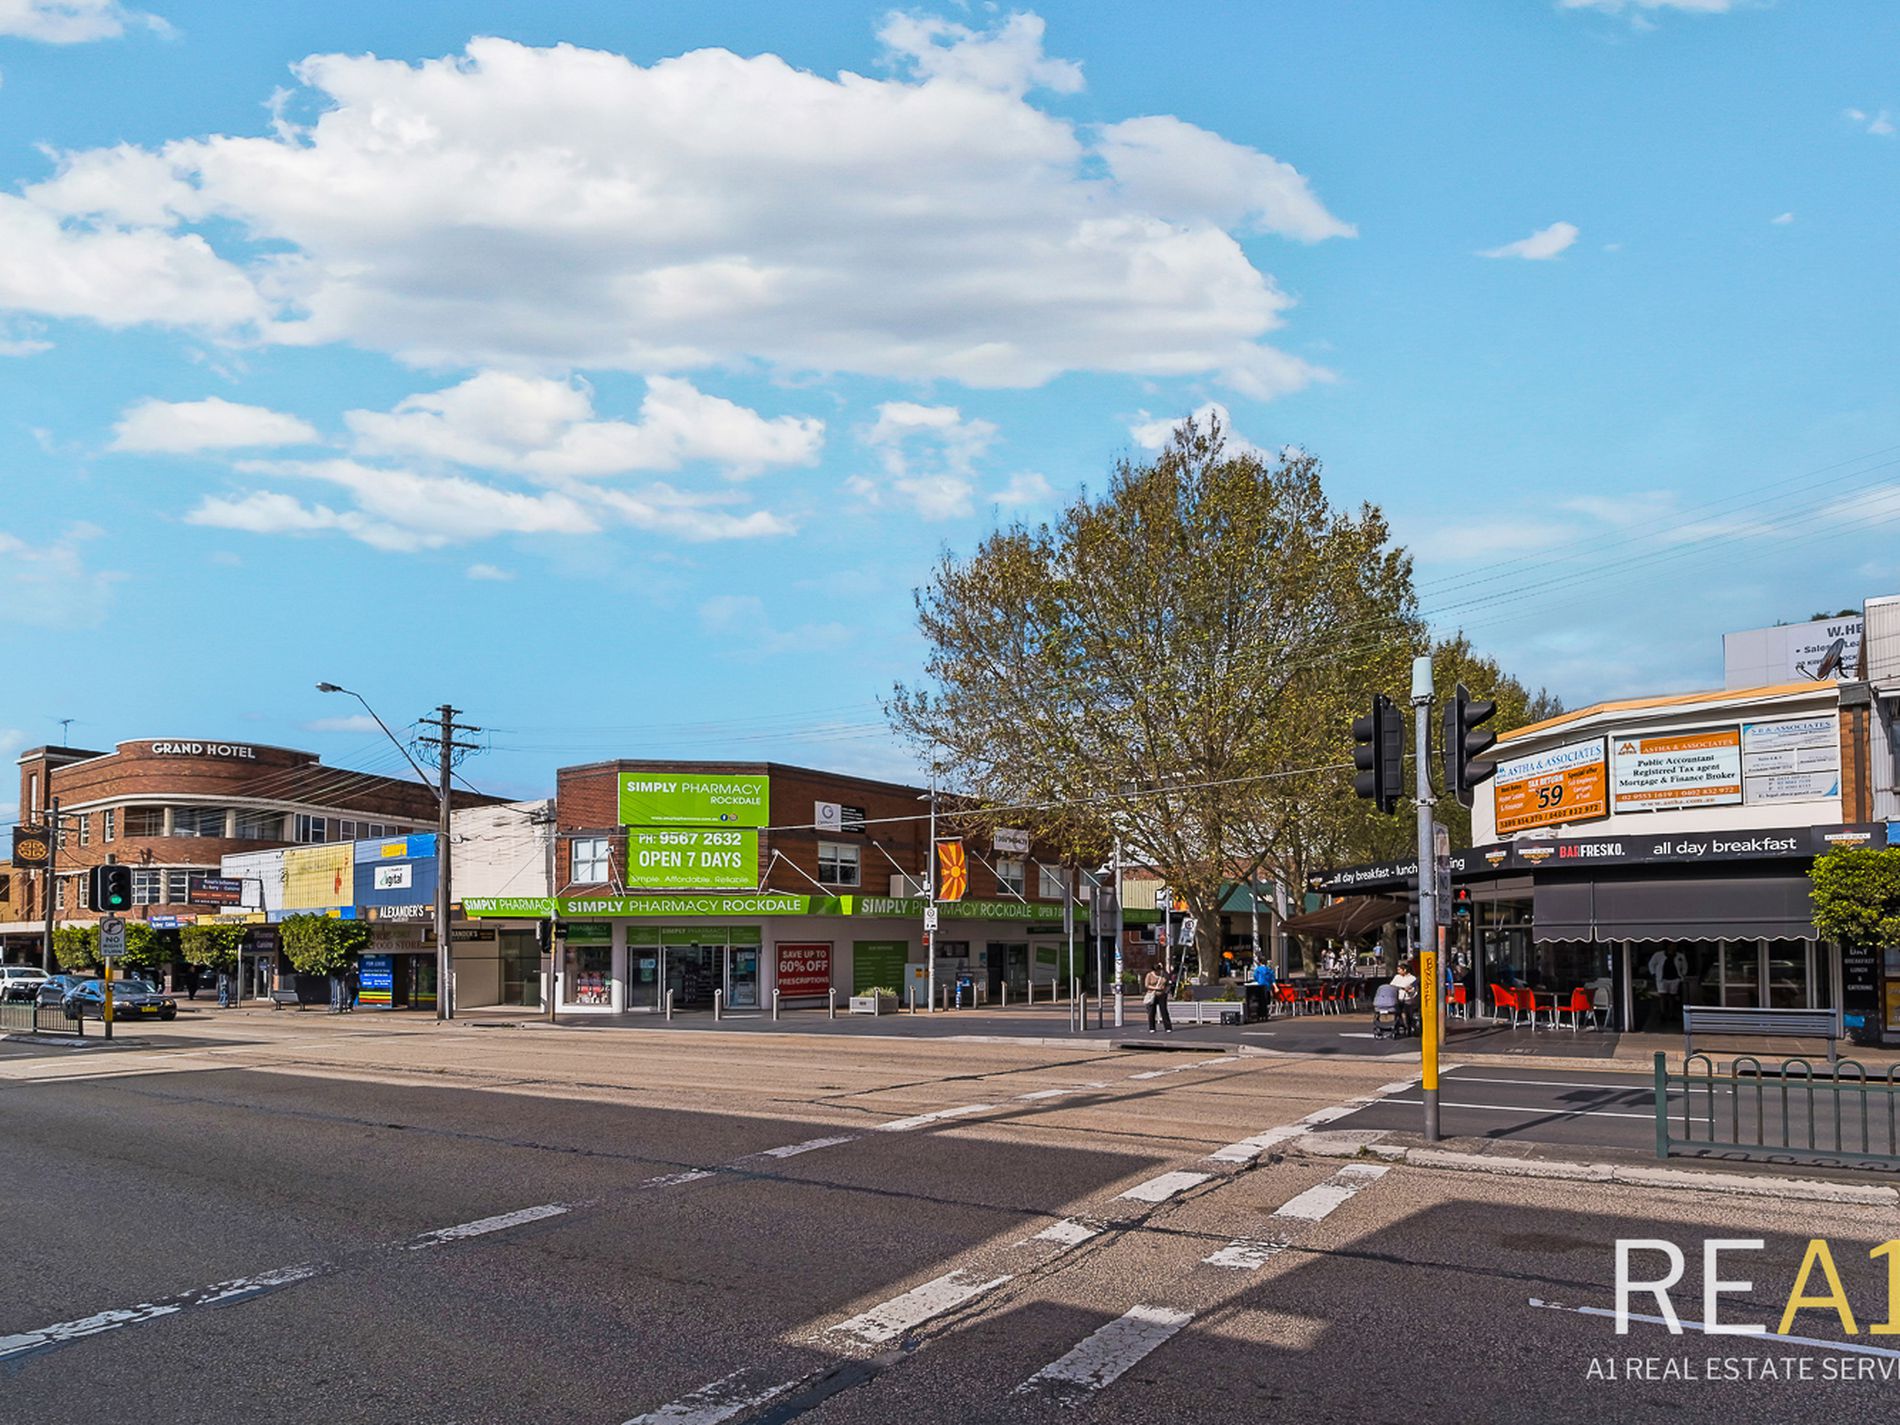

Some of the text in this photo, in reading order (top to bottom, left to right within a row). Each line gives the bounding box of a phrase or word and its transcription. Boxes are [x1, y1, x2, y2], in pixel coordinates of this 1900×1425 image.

[1682, 738, 1734, 749] ASSOCIATES
[151, 742, 256, 759] GRAND HOTEL
[1508, 763, 1535, 776] ASTHA
[1536, 761, 1543, 769] &
[1546, 745, 1602, 765] ASSOCIATES
[1637, 755, 1715, 767] Public Accountant
[1633, 766, 1676, 776] Registered
[1697, 764, 1720, 772] agent
[1619, 778, 1658, 787] Mortgage
[1706, 772, 1735, 780] Broker
[626, 781, 762, 795] SIMPLY PHARMACY
[710, 796, 761, 806] ROCKDALE
[639, 832, 742, 845] PH: 9567 2632
[1653, 837, 1797, 856] all day breakfast
[639, 851, 742, 868] OPEN 7 DAYS
[1333, 873, 1341, 883] all
[1342, 872, 1355, 884] day
[1355, 867, 1390, 880] breakfast
[1396, 862, 1418, 875] lunch
[380, 904, 424, 918] ALEXANDER'S
[465, 899, 556, 912] SIMPLY PHARMACY
[567, 899, 801, 912] SIMPLY PHARMACY ROCKDALE
[861, 899, 1032, 918] SIMPLY PHRMACY ROCKDALE
[783, 950, 827, 959] SAVE UP TO
[780, 960, 828, 972] 60% OFF
[779, 976, 829, 985] PRESCRIPTIONS
